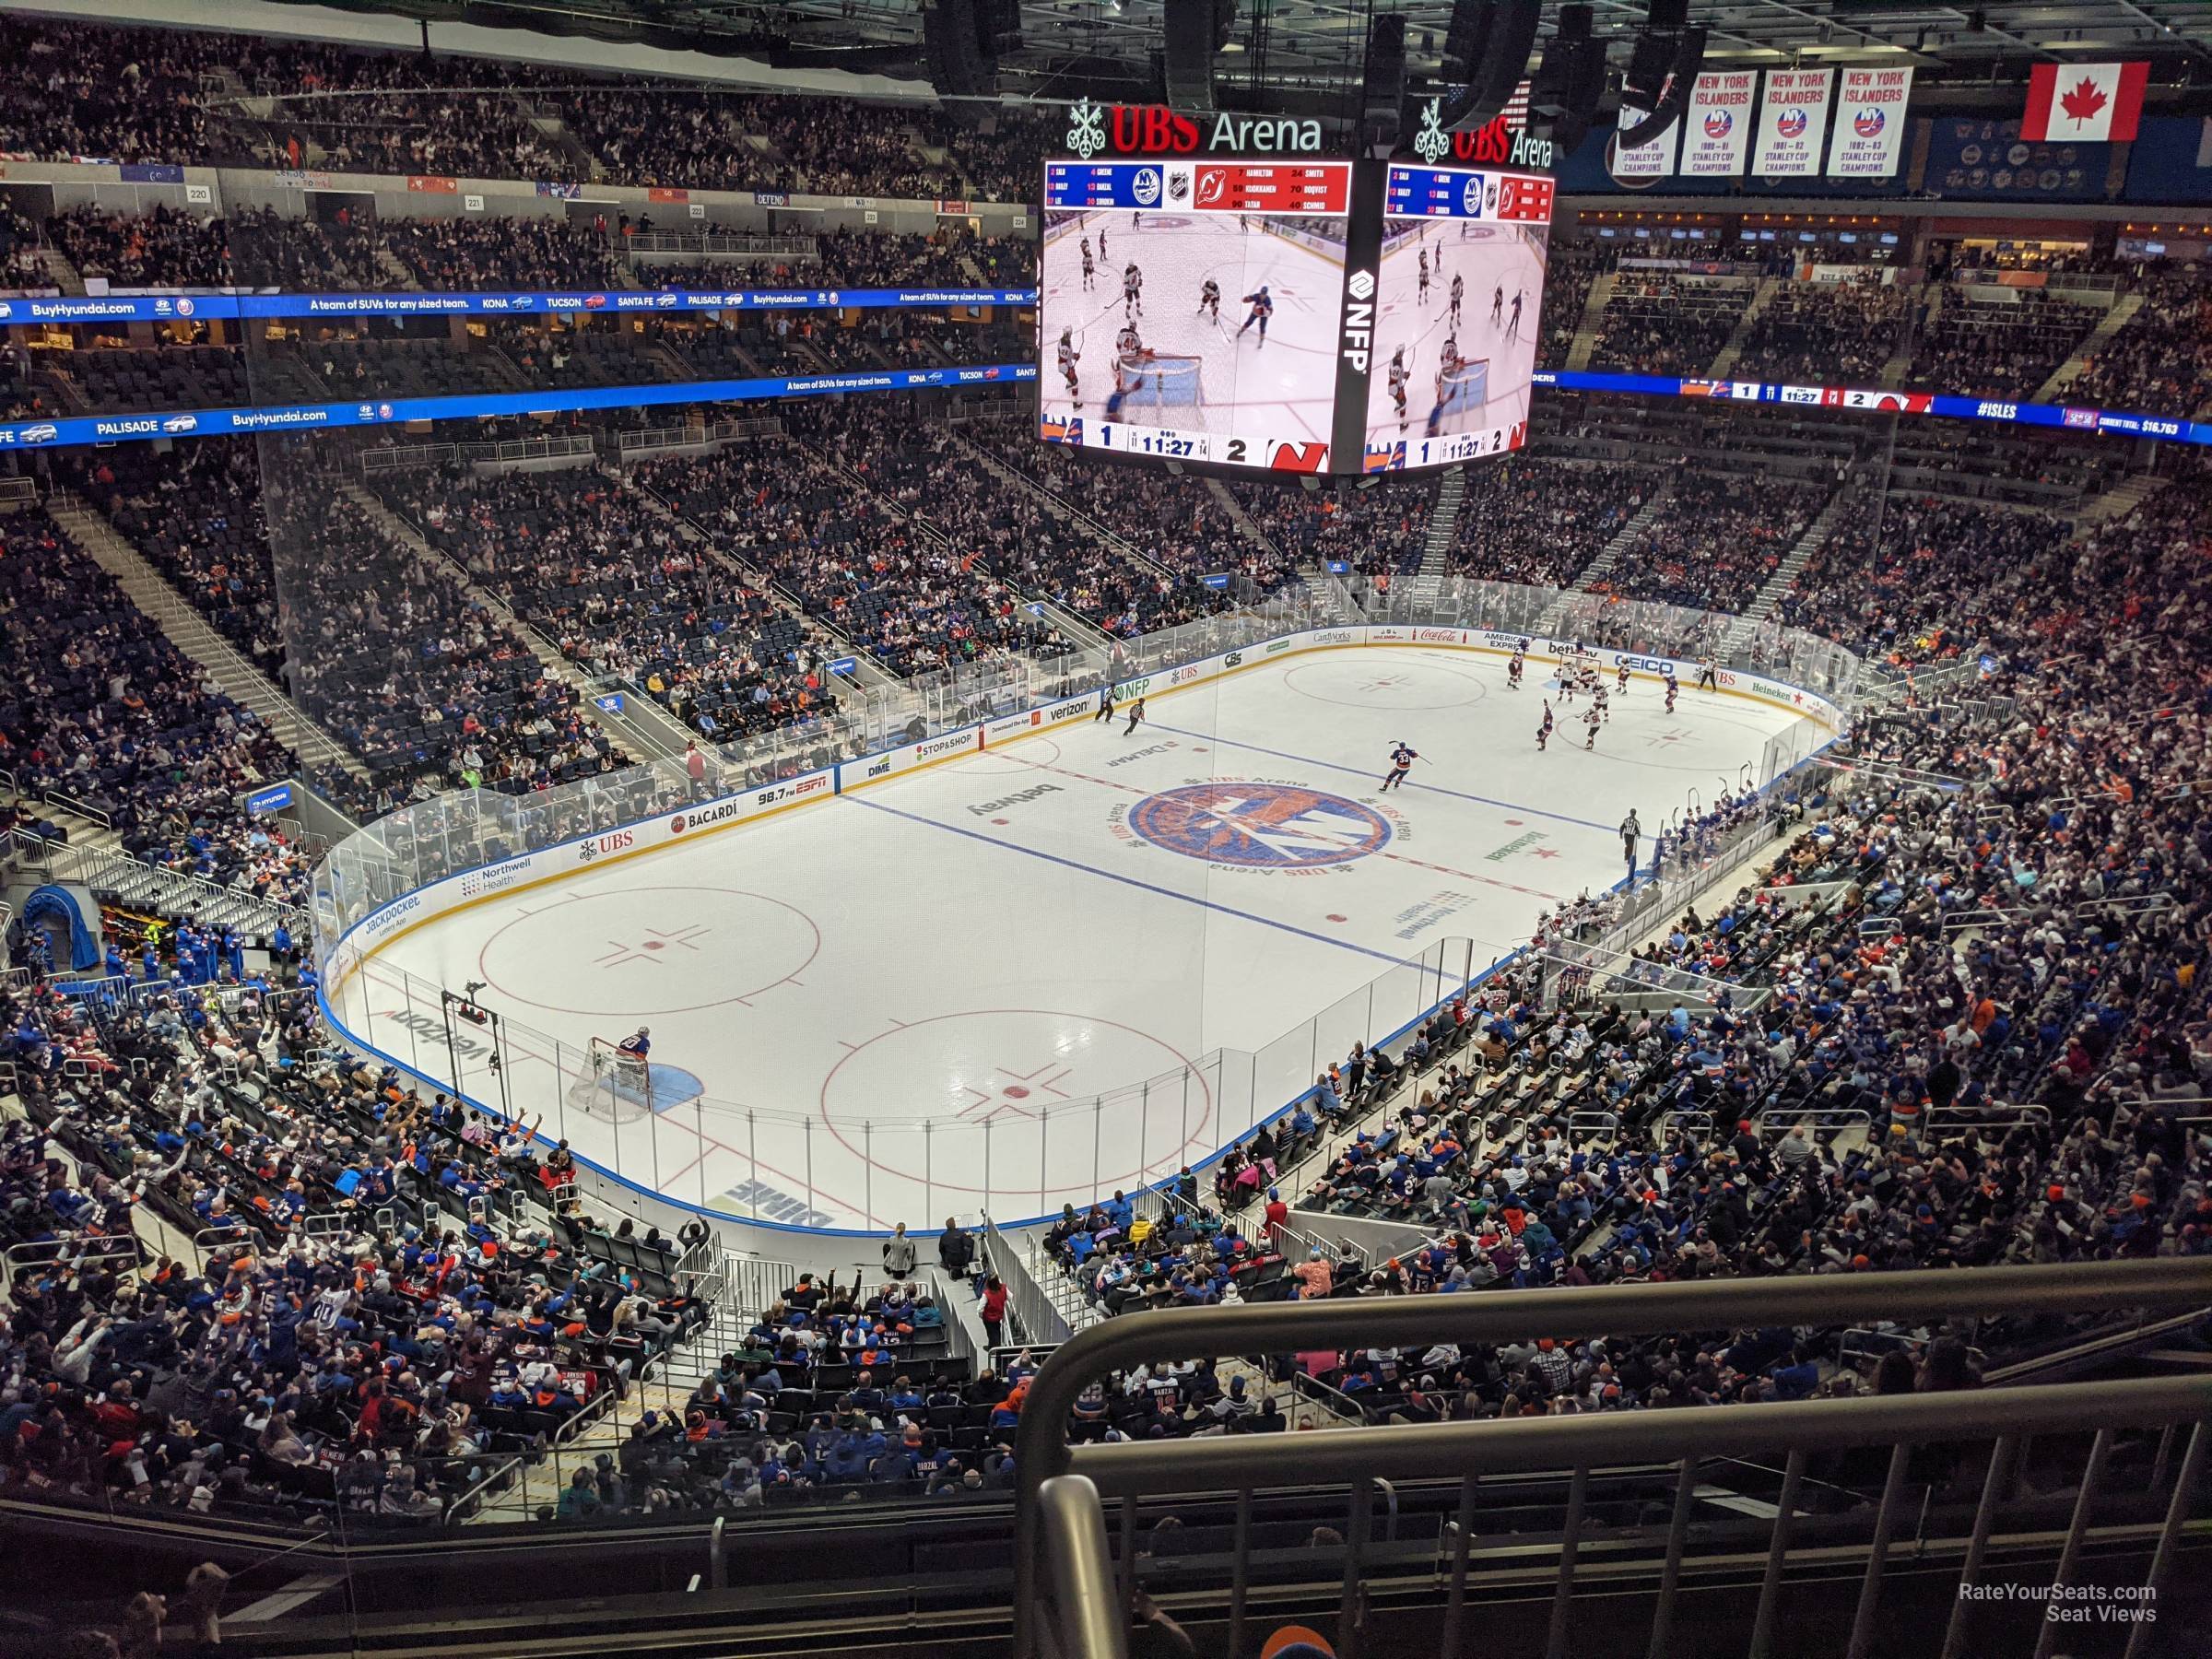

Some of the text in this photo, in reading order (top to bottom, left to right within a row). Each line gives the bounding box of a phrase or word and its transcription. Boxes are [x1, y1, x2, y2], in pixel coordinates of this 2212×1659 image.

[1698, 75, 1749, 89] NEW YORK
[1771, 73, 1825, 88] NEW YORK
[1848, 72, 1904, 87] NEW YORK
[1695, 89, 1748, 106] ISLANDERS
[1769, 88, 1823, 104] ISLANDERS
[1844, 88, 1902, 103] ISLANDERS
[1112, 104, 1321, 155] UBS Arena
[1454, 115, 1552, 169] UBS Arena
[1623, 153, 1665, 162] STANLEY CUP
[1692, 153, 1735, 162] STANLEY CUP
[1765, 152, 1809, 162] STANLEY CUP
[1841, 152, 1887, 161] STANLEY CUP
[1624, 163, 1661, 172] CHAMPIONS
[1692, 163, 1731, 172] CHAMPIONS
[1765, 163, 1804, 172] CHAMPIONS
[1841, 163, 1883, 172] CHAMPIONS
[191, 190, 207, 199] 220
[1290, 184, 1301, 193] 70
[468, 199, 480, 207] 221
[759, 194, 784, 205] DEFEND
[692, 207, 703, 216] 222
[547, 298, 582, 308] TUCSON
[618, 297, 654, 307] SANTA FE
[688, 296, 723, 305] PALISADE
[753, 295, 807, 305] BuyHyundai.com
[906, 294, 920, 302] team
[920, 293, 926, 301] of
[926, 293, 940, 301] SUVs
[948, 294, 959, 303] any
[960, 292, 976, 301] sized
[977, 293, 995, 301] team.
[1005, 293, 1024, 301] KONA
[33, 302, 135, 318] BuyHyundai.com
[311, 298, 469, 312] A team of SUVs for any sized team.
[483, 300, 509, 309] KONA
[1344, 303, 1372, 373] NFP
[909, 374, 926, 383] KONA
[959, 371, 982, 380] TUCSON
[794, 382, 811, 390] team
[811, 380, 818, 389] of
[818, 379, 836, 388] SUVs
[836, 378, 845, 387] for
[845, 378, 857, 389] any
[857, 376, 873, 386] sized
[874, 376, 892, 385] team.
[1742, 385, 1749, 396] 1
[1786, 391, 1817, 403] 11:27
[1853, 394, 1864, 405] 2
[1977, 403, 2017, 418] #ISLES
[232, 410, 327, 427] BuyHyundai.com
[2099, 418, 2140, 430] CURRENT TOTAL:
[99, 421, 159, 435] PALISADE
[0, 431, 15, 443] FE
[1100, 425, 1112, 446] 1
[1131, 437, 1137, 447] 11
[1492, 430, 1501, 452] 2
[1143, 437, 1194, 456] 11:27
[1199, 444, 1207, 455] 14
[1227, 439, 1247, 462] 2
[1420, 441, 1430, 463] 1
[1450, 441, 1479, 459] 11:27
[1313, 630, 1351, 643] CardWorks
[1420, 629, 1456, 643] Coca-Cola
[1484, 632, 1531, 646] AMERICAN
[1615, 654, 1674, 675] GEICO
[1180, 665, 1197, 682] UBS
[1126, 678, 1150, 700] NFP
[1752, 682, 1791, 701] Heineken
[1051, 700, 1088, 723] verizon
[992, 724, 1014, 735] Download
[1021, 719, 1030, 728] App
[1106, 745, 1169, 768] DELMAR
[1398, 753, 1409, 763] 33
[868, 762, 890, 778] DIME
[1251, 777, 1309, 788] Arena
[759, 776, 827, 806] 98.7 FM ESPN
[261, 793, 288, 806] HYUNDAI
[966, 783, 1065, 817] betway
[688, 799, 737, 829] BACARDÍ
[1105, 803, 1131, 840] UBS Arena
[1395, 820, 1411, 841] Arena
[598, 830, 633, 853] UBS
[1483, 830, 1549, 862] Heineken
[482, 858, 531, 880] Northwell
[1209, 863, 1329, 877] UBS Arena
[483, 876, 514, 891] Health
[379, 916, 406, 937] Lottery App
[1394, 907, 1457, 940] Northwell
[391, 1010, 489, 1060] verizon
[916, 1461, 938, 1472] BARZAL
